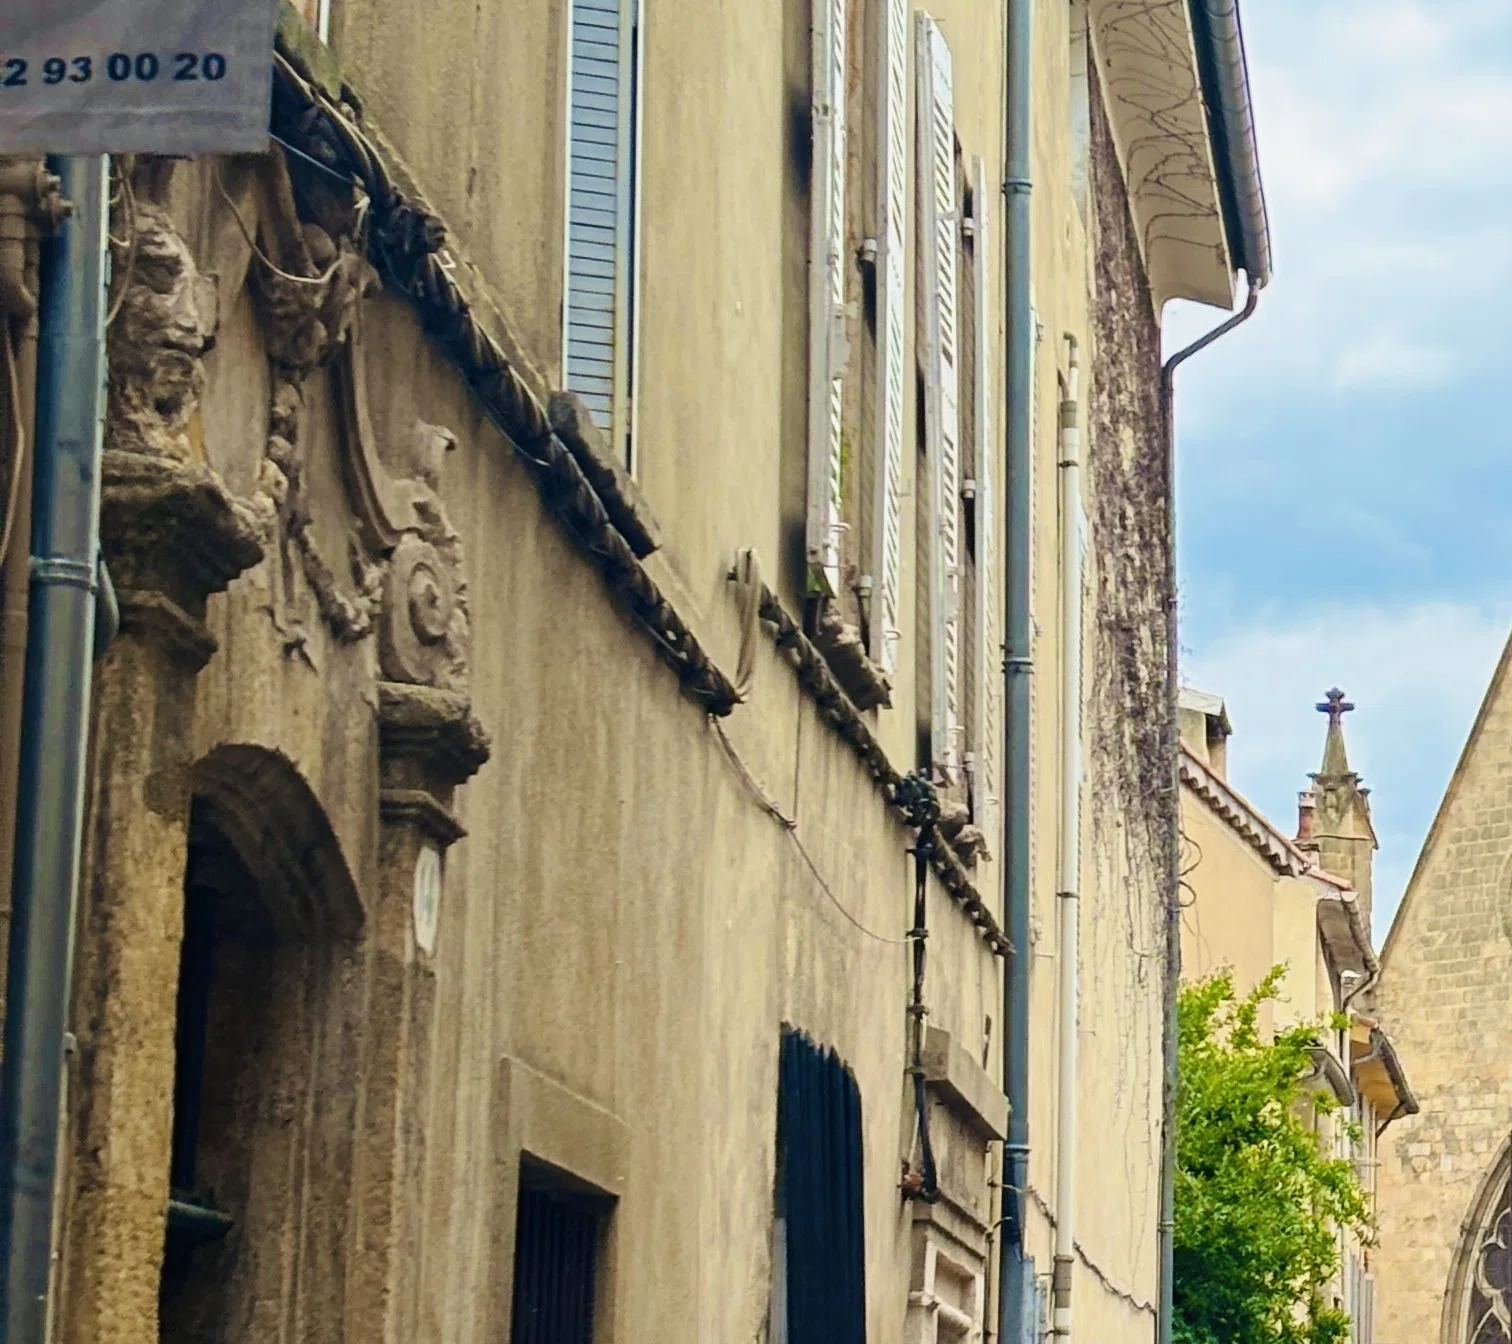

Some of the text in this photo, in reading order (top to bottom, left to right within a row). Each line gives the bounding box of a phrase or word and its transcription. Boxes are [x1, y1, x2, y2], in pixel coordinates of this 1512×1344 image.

[43, 56, 93, 84] 93
[106, 52, 159, 82] 00
[172, 52, 227, 81] 20
